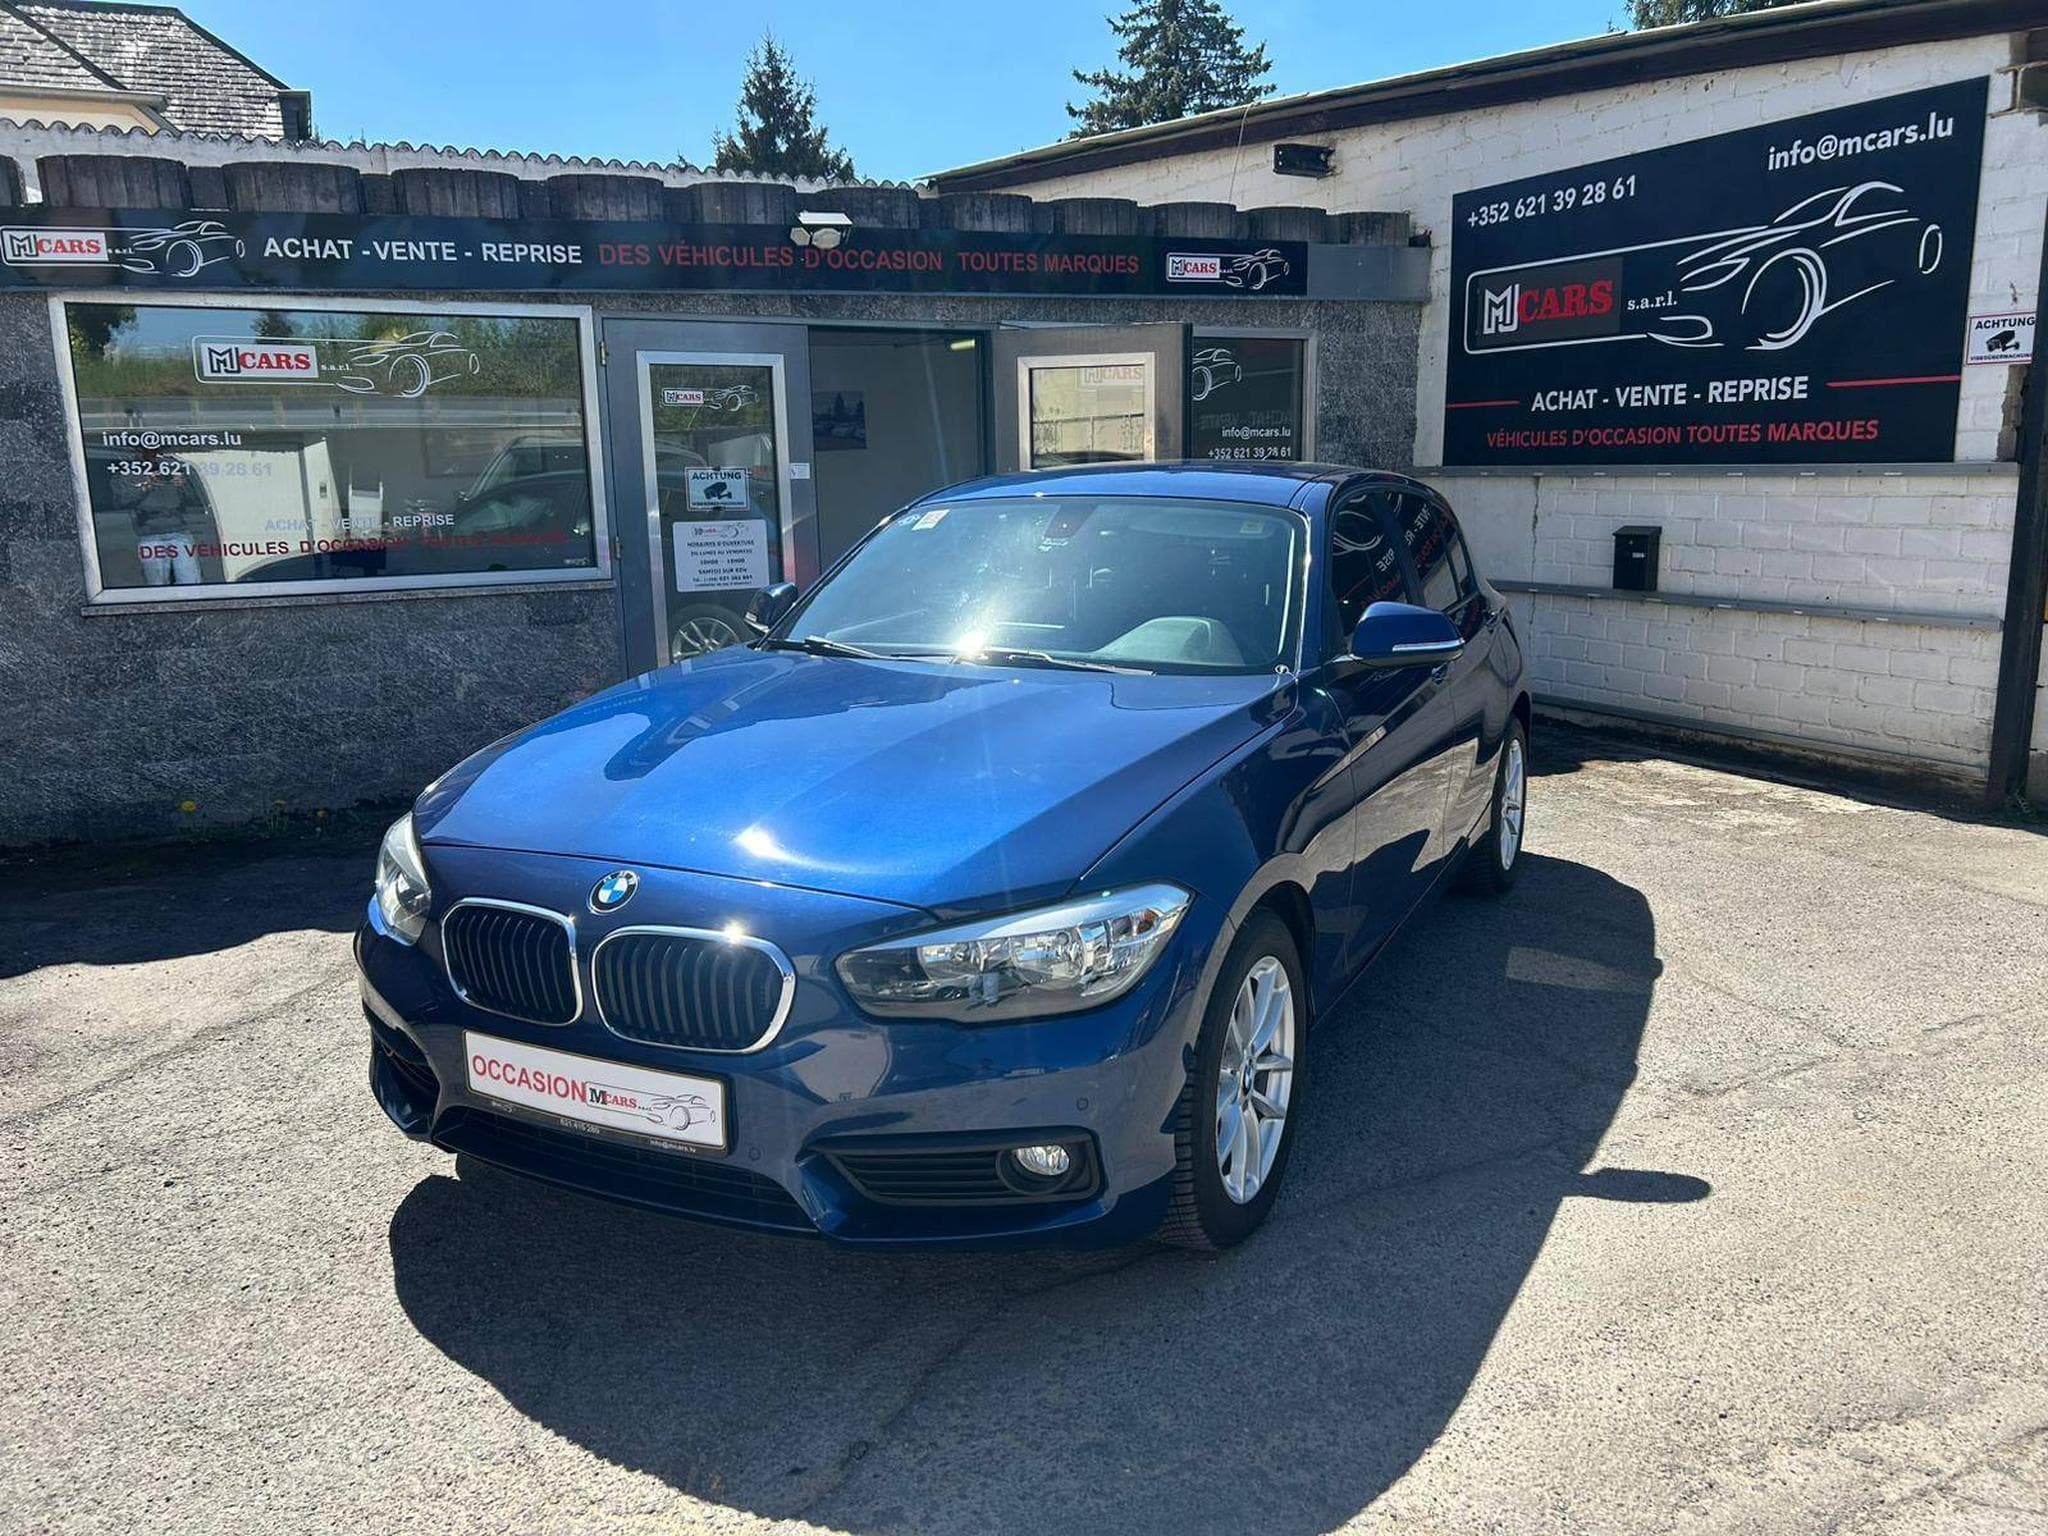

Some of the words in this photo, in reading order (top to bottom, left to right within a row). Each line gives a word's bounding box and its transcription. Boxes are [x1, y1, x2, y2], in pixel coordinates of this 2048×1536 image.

[1768, 112, 1954, 171] info@mcars.lu
[1467, 202, 1510, 228] +352
[1514, 194, 1546, 219] 621
[1553, 187, 1577, 212] 39
[1582, 181, 1606, 206] 28
[1612, 174, 1636, 200] 61
[263, 237, 353, 259] ACHAT
[481, 243, 583, 264] REPRISE
[600, 244, 651, 266] DES
[658, 239, 794, 267] VÉHICULES
[804, 246, 942, 270] D'OCCASION
[959, 250, 1038, 272] TOUTES
[1044, 253, 1140, 274] MARQUES
[1627, 291, 1678, 311] s.a.r.l.
[1975, 316, 2036, 330] ACHTUNG
[1531, 390, 1597, 412] ACHAT
[1615, 383, 1687, 407] VENTE
[1707, 376, 1809, 403] REPRISE
[102, 431, 242, 449] info@mcars.lu
[1222, 427, 1291, 440] info@mcars.lu
[1487, 428, 1567, 448] VÉHICULES
[1572, 427, 1681, 446] D'OCCASION
[1687, 424, 1761, 443] TOUTES
[1767, 419, 1879, 442] MARQUES
[1234, 447, 1250, 458] 621
[1281, 447, 1292, 457] 61
[107, 461, 153, 476] +352
[159, 462, 191, 476] 621
[691, 472, 742, 480] ACHTUNG
[393, 514, 455, 527] REPRISE
[139, 545, 178, 559] DES
[472, 1054, 588, 1104] OCCASION
